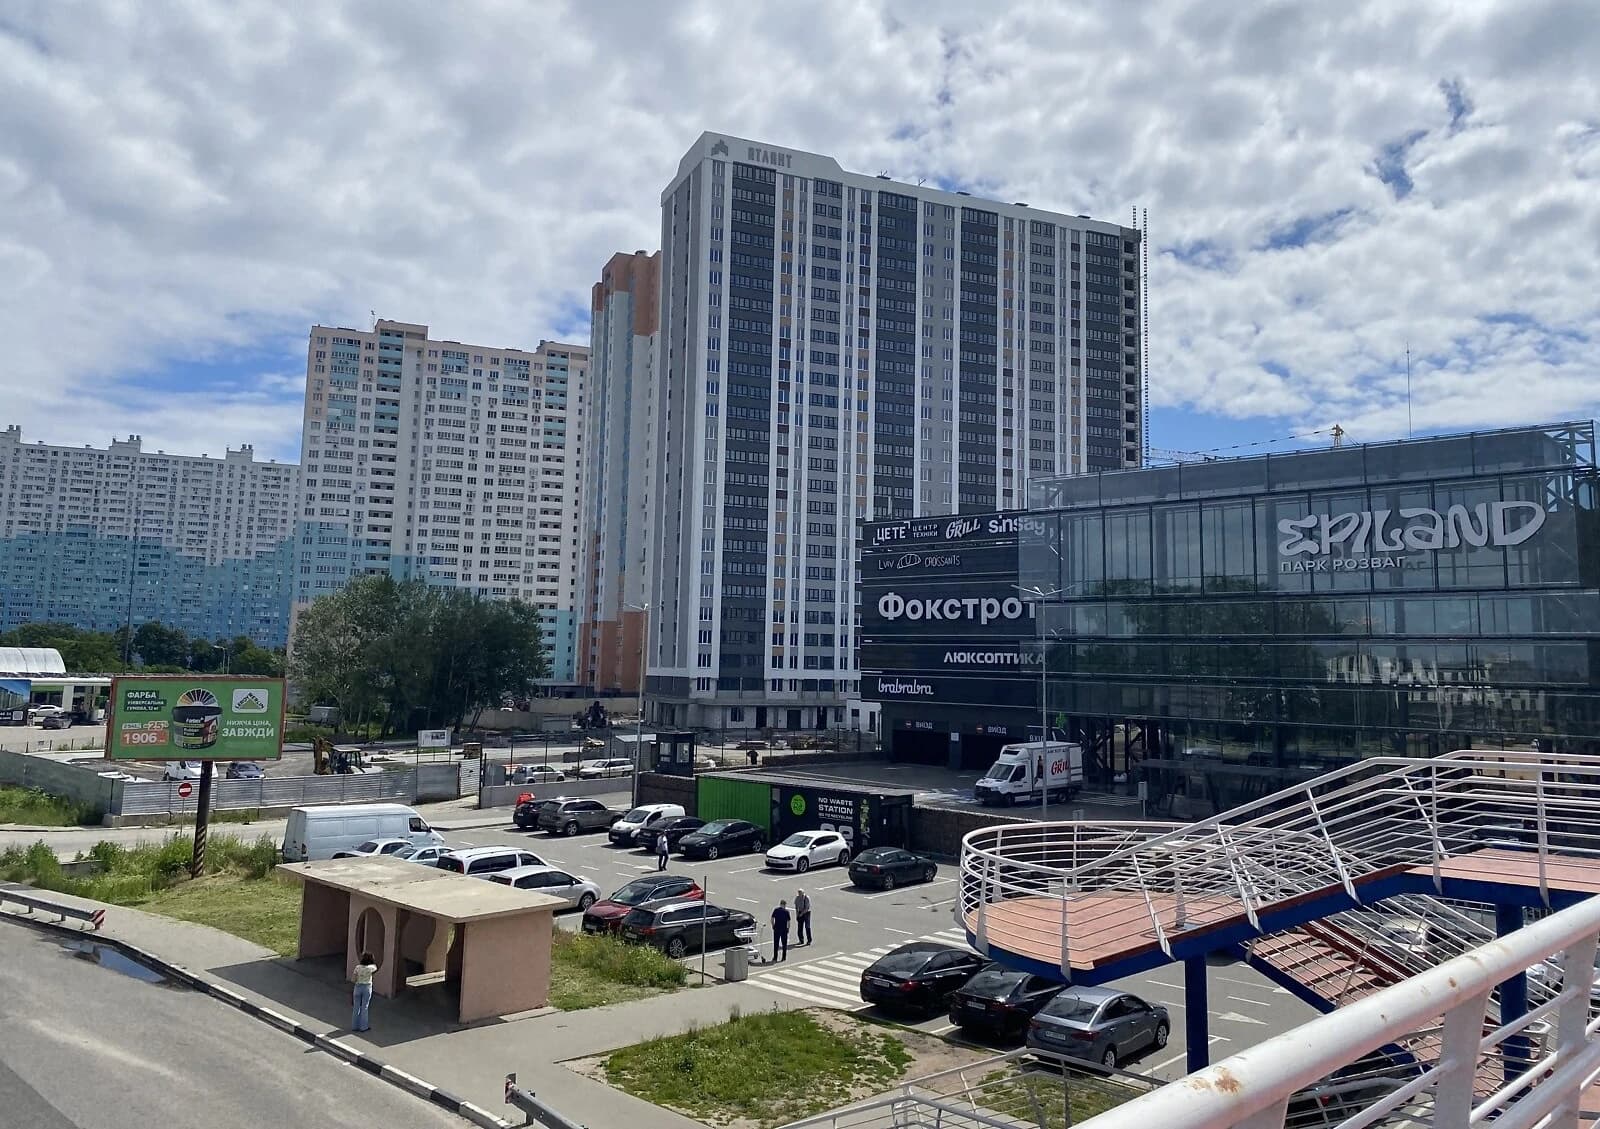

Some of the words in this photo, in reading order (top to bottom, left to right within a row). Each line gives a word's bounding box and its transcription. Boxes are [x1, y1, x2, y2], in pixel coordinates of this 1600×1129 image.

[913, 524, 938, 532] ЦЕНТР
[945, 518, 981, 539] GRILL
[988, 515, 1046, 536] sinsay
[877, 526, 906, 541] ЦЕТЕ
[1281, 559, 1328, 572] ПАРК
[1333, 556, 1406, 569] РОЗВАГ
[943, 652, 1046, 665] ЛЮКСОПТИКА
[878, 678, 934, 695] brabrabra
[127, 691, 157, 699] ФАРБА
[222, 728, 274, 738] ЗАВЖДИ
[829, 798, 853, 806] WASTE
[818, 804, 853, 815] STATION
